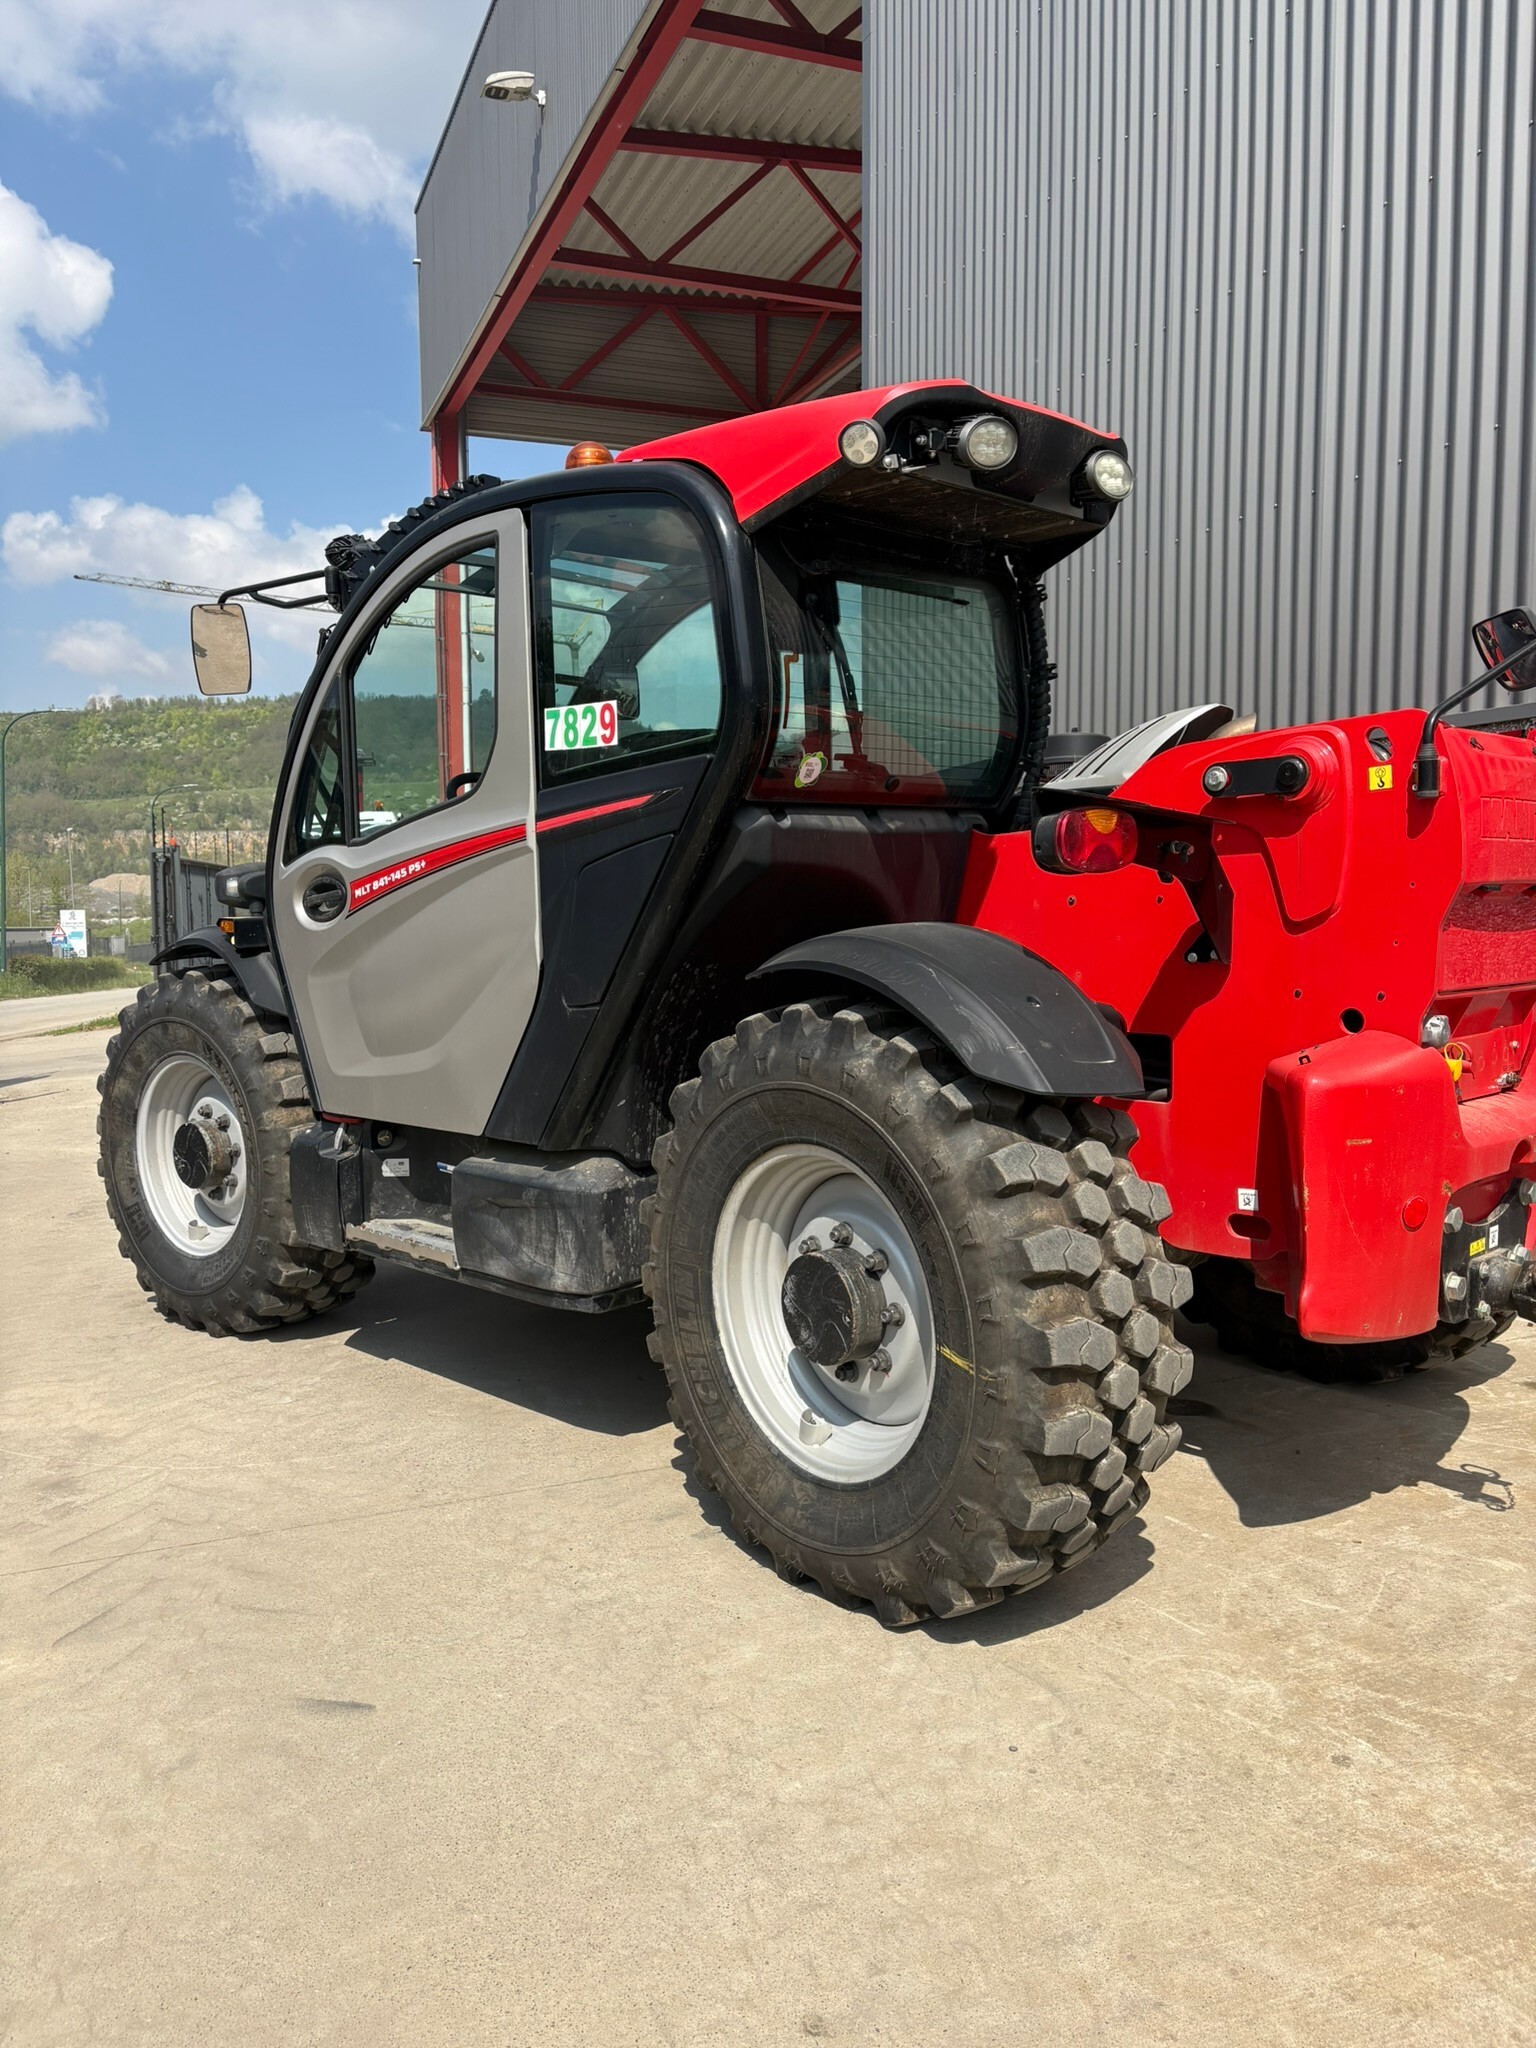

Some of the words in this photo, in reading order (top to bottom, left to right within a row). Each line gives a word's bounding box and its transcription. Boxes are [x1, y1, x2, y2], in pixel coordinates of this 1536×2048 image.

[546, 703, 616, 748] 7829
[354, 883, 371, 899] MLT
[372, 867, 407, 890] 841-145
[408, 859, 426, 875] PS+
[673, 1264, 748, 1447] MICHELIN
